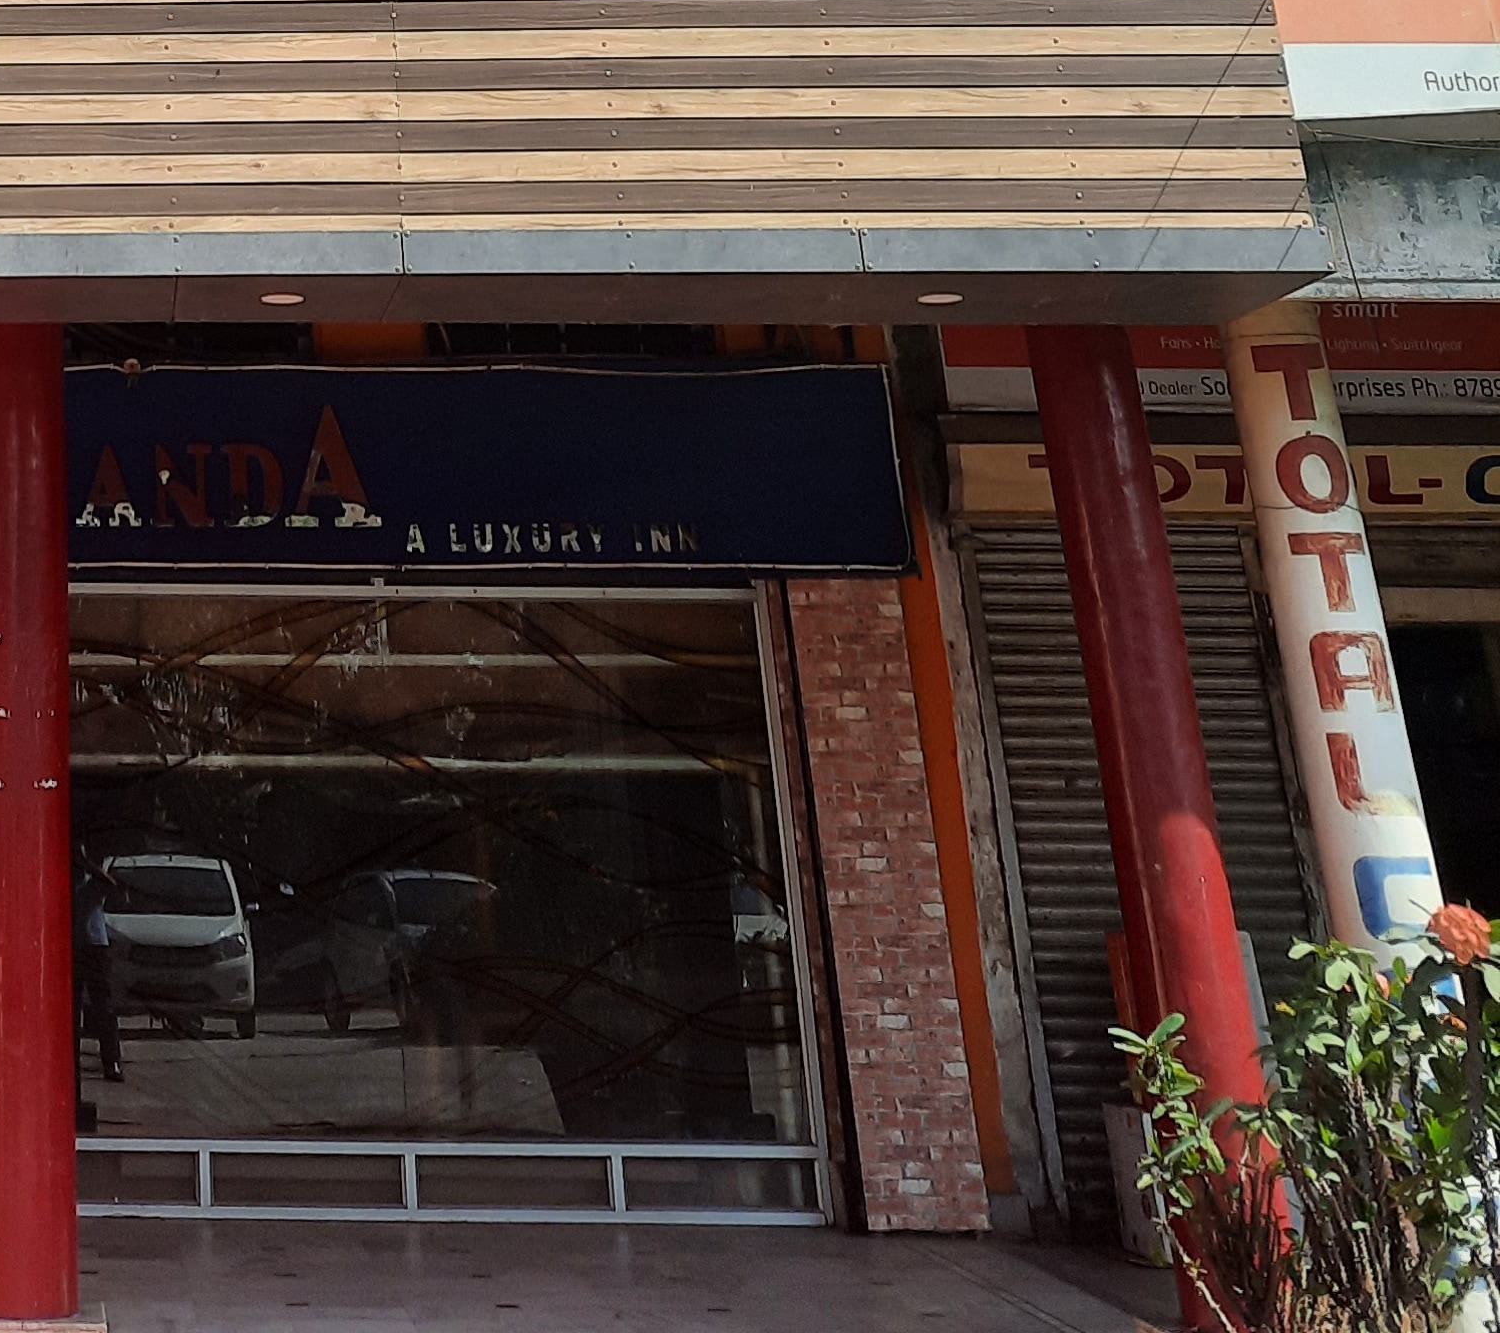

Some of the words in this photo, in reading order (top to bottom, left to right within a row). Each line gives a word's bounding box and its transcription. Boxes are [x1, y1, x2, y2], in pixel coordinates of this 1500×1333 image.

[1423, 70, 1500, 92] Author
[406, 523, 426, 554] A
[449, 523, 601, 554] LUXURY
